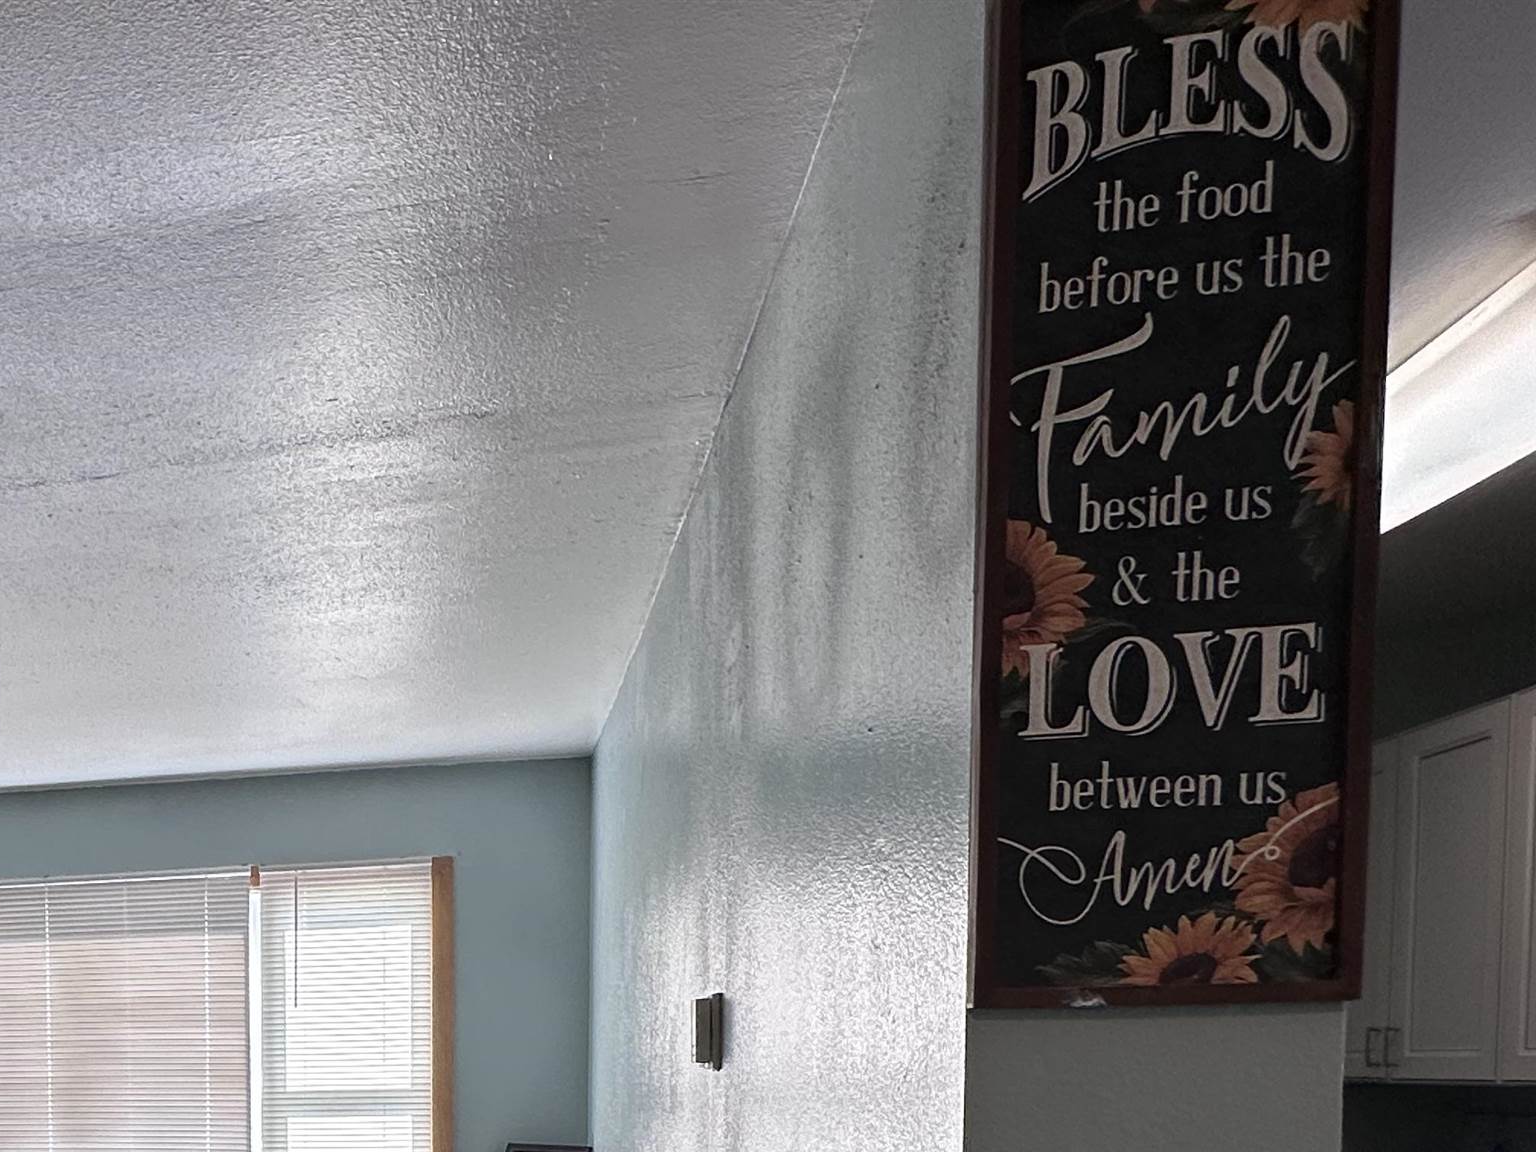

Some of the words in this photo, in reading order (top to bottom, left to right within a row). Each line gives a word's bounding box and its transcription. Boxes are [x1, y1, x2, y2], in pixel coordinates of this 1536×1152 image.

[1022, 20, 1353, 202] BLESS
[1093, 180, 1160, 233] the
[1177, 160, 1274, 224] food
[1038, 256, 1179, 314] before
[1196, 258, 1243, 296] us
[1259, 233, 1331, 288] the
[1009, 312, 1358, 523] Family
[1078, 475, 1207, 534] beside
[1225, 485, 1273, 522] us
[1111, 555, 1152, 606] &
[1171, 551, 1240, 602] the
[1018, 622, 1325, 741] LOVE
[1049, 761, 1222, 812] between
[1239, 771, 1288, 805] us
